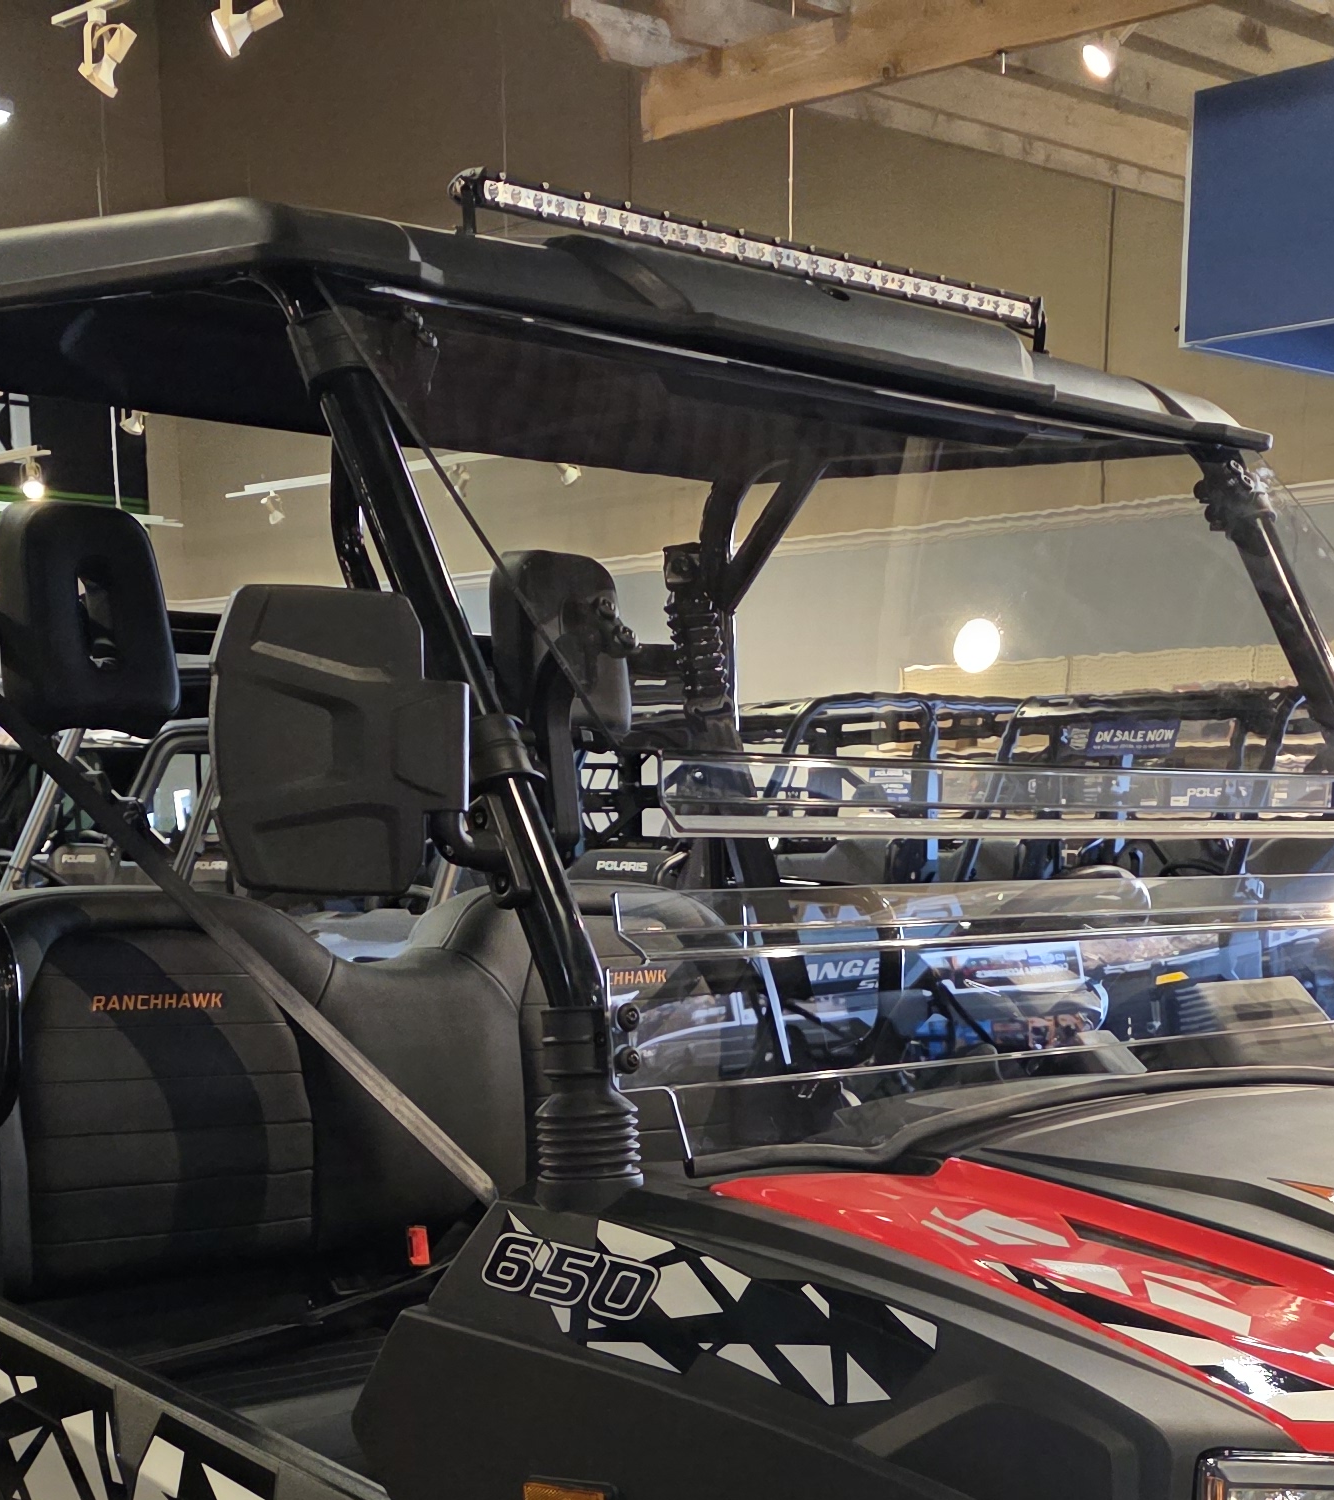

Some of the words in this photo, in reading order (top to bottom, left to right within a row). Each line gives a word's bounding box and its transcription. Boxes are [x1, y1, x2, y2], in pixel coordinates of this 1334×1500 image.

[1113, 730, 1144, 743] SALE
[1146, 728, 1176, 743] NOW
[596, 860, 648, 872] POLARIS
[608, 969, 667, 986] CHHAWK
[91, 992, 223, 1012] RANCHHAWK
[481, 1232, 661, 1321] 650
